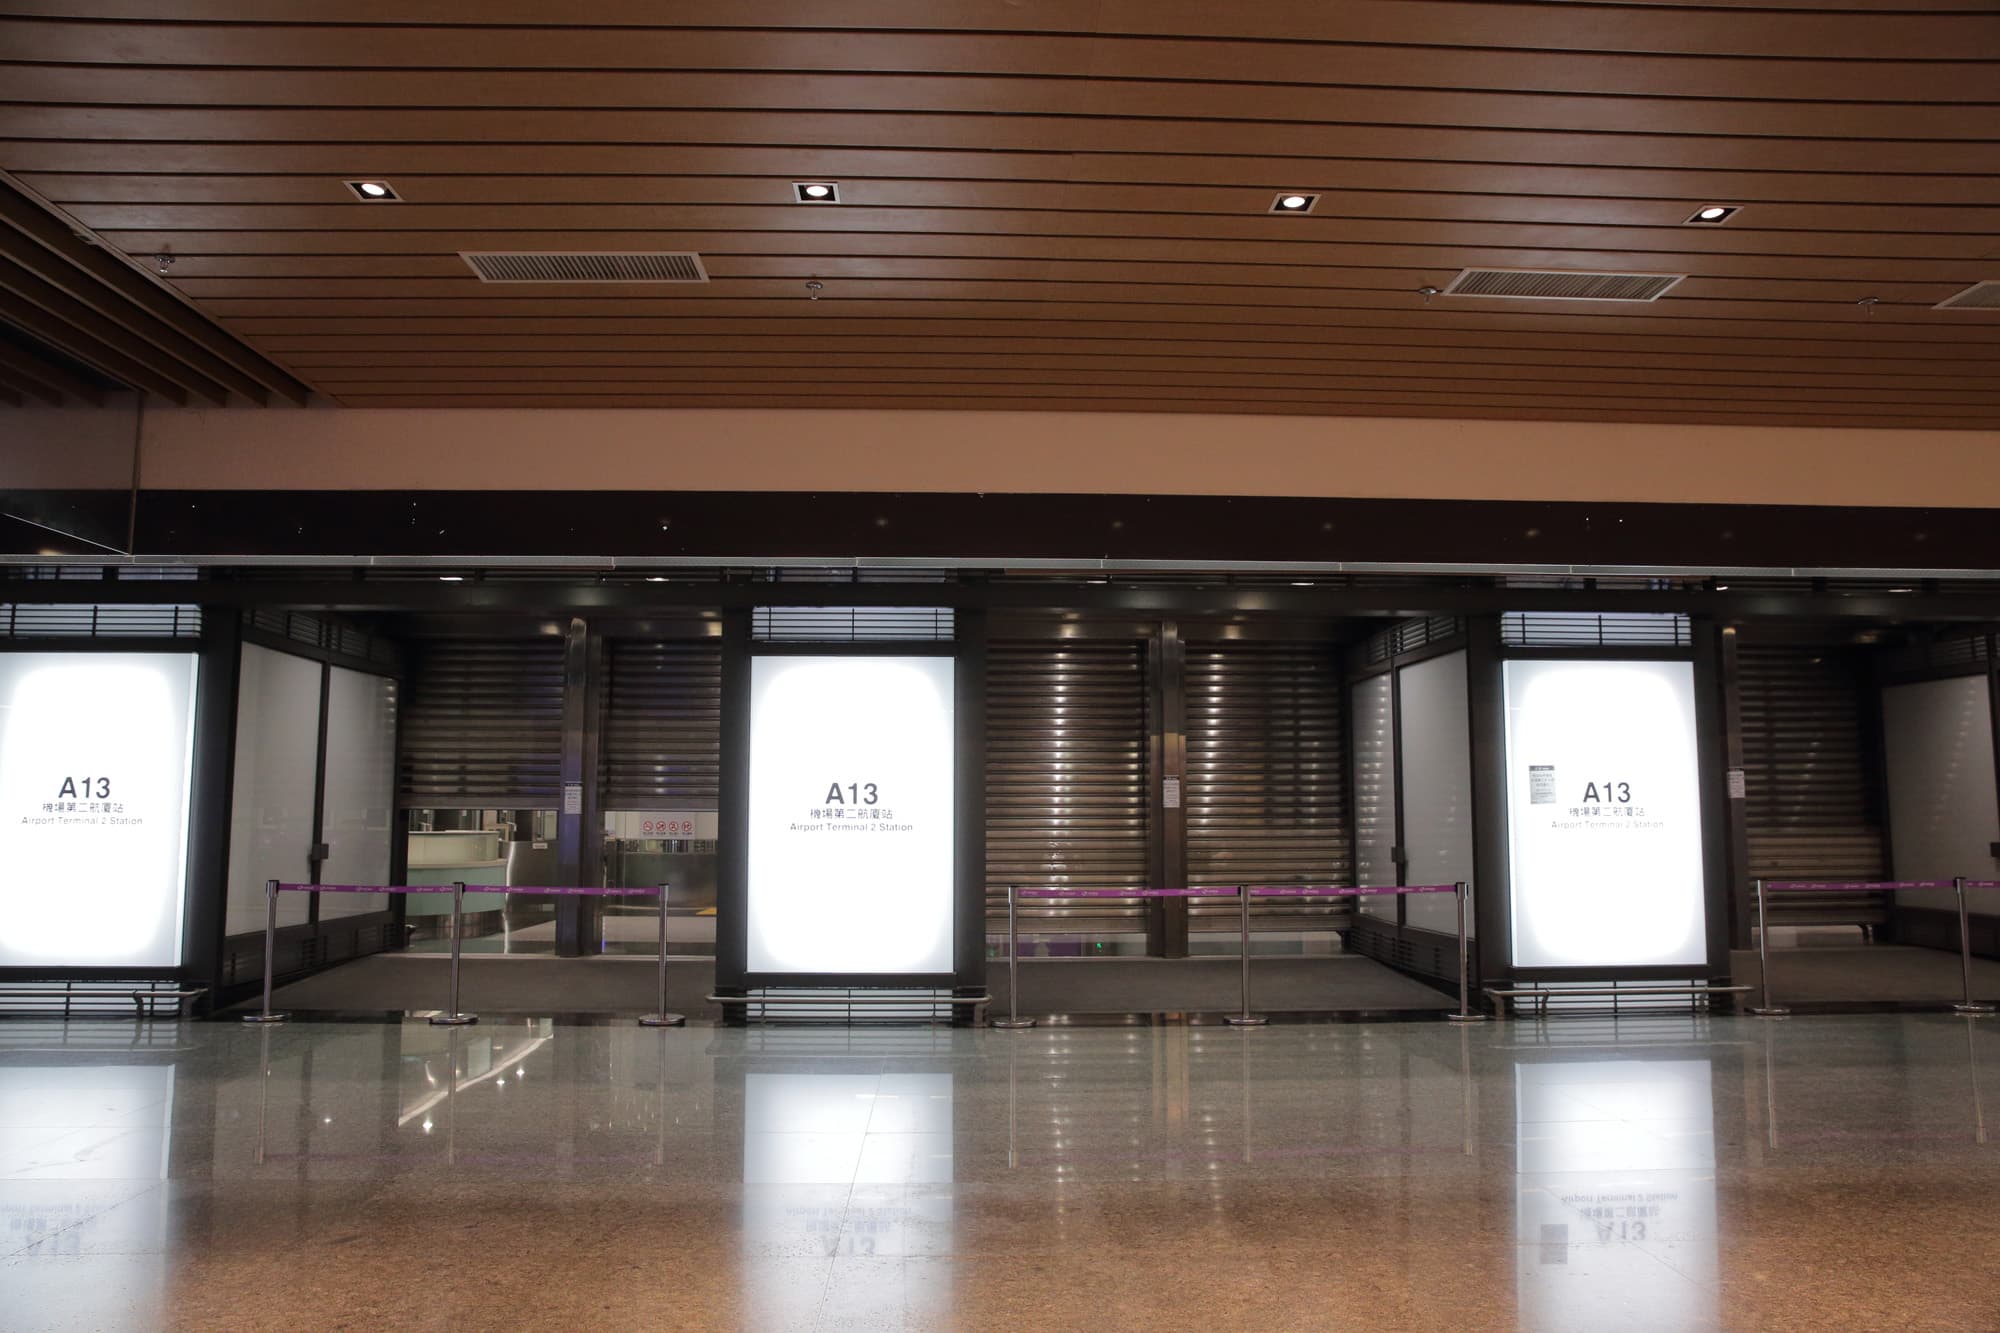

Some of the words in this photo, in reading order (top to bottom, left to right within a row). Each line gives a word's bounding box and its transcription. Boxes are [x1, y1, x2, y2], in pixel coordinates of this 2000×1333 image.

[58, 776, 111, 799] A13
[825, 782, 878, 805] A13
[1583, 782, 1631, 803] A13
[809, 808, 893, 820] 機場第二航廈站
[20, 816, 55, 826] Airport
[58, 816, 98, 825] Terminal
[110, 816, 143, 825] Station
[1552, 820, 1582, 830] Airport
[1633, 820, 1664, 829] Station
[790, 823, 823, 833] Airport
[826, 823, 868, 832] Terminal
[879, 823, 913, 832] Station
